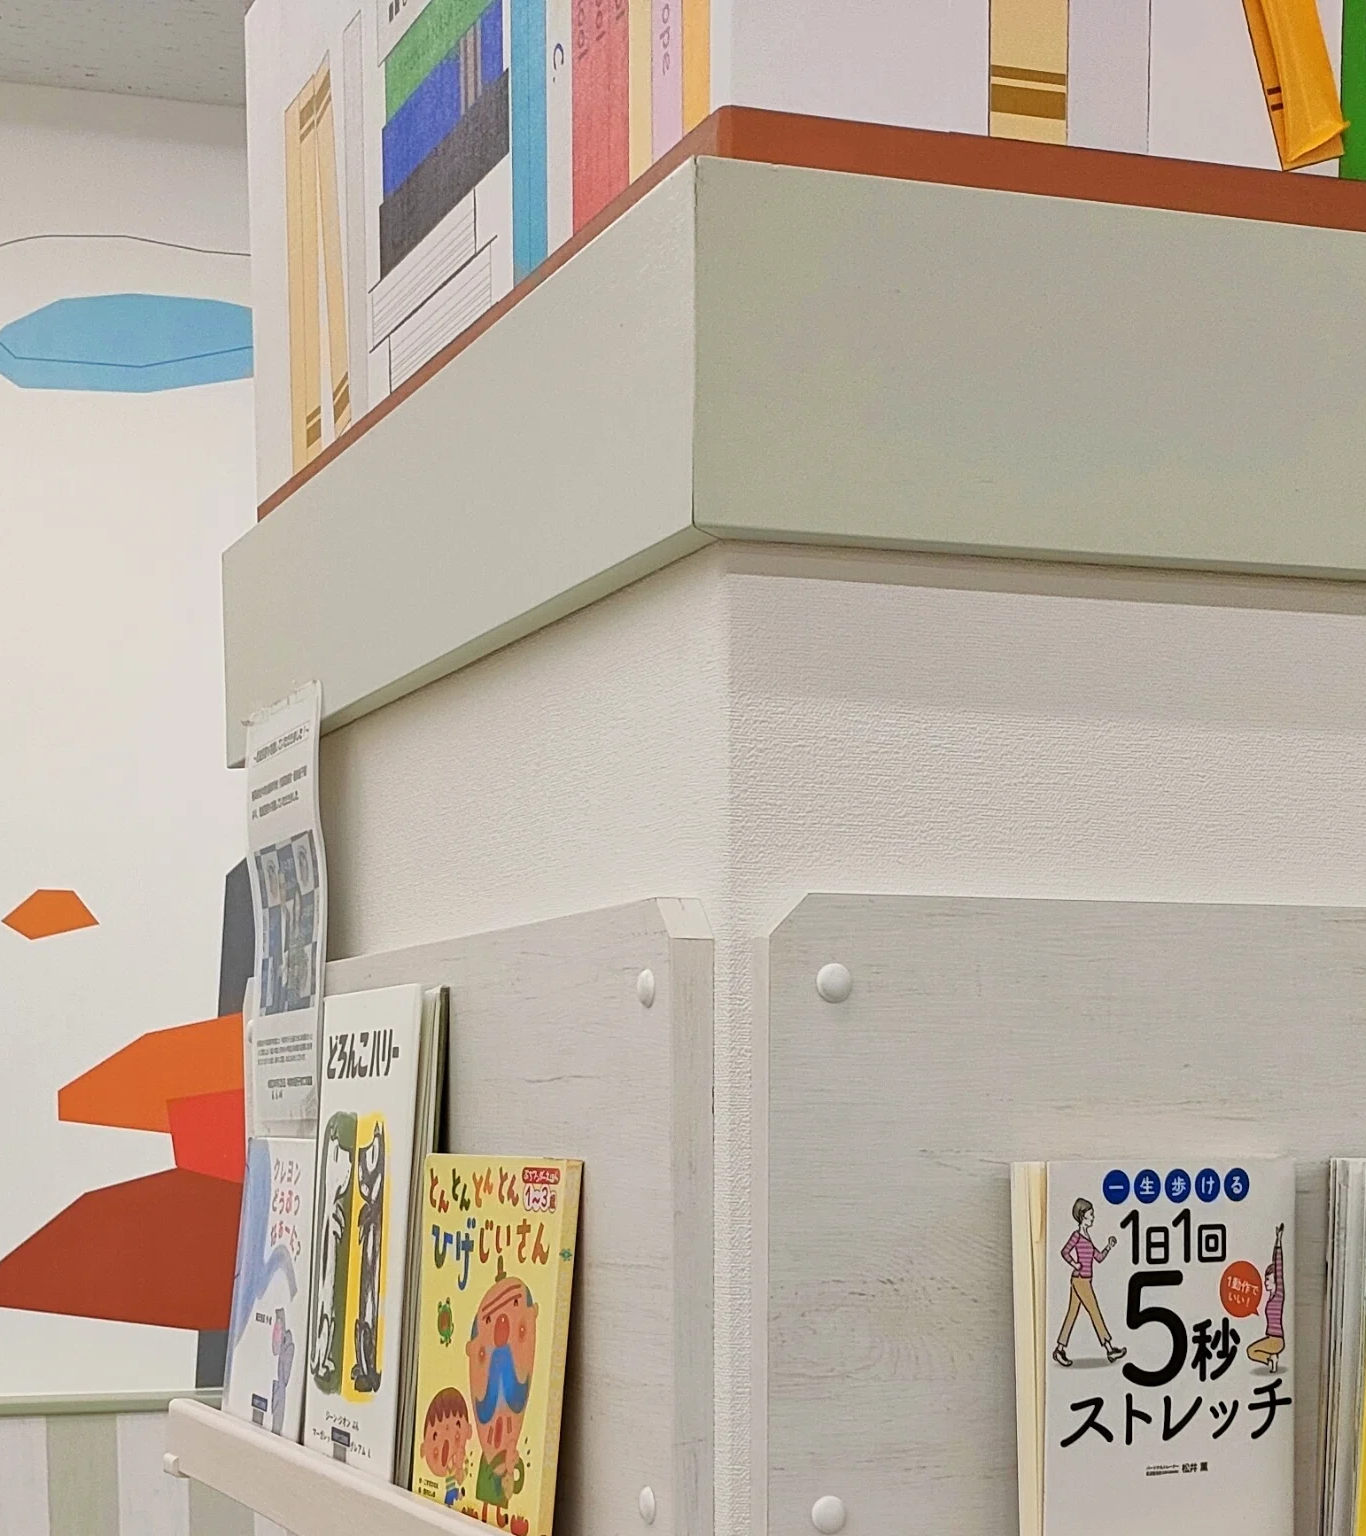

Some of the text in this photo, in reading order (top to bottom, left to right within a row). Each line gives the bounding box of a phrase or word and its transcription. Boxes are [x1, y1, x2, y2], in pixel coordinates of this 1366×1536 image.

[326, 1028, 400, 1080] どろんこハリー
[273, 1157, 302, 1186] クレヨン
[1105, 1171, 1247, 1201] 一生歩ける
[271, 1188, 301, 1217] どうぶつ
[431, 1217, 551, 1291] ひげじいさん
[1119, 1207, 1228, 1266] 1日1回
[1121, 1270, 1242, 1388] 5秒
[1059, 1377, 1294, 1449] ストレッチ
